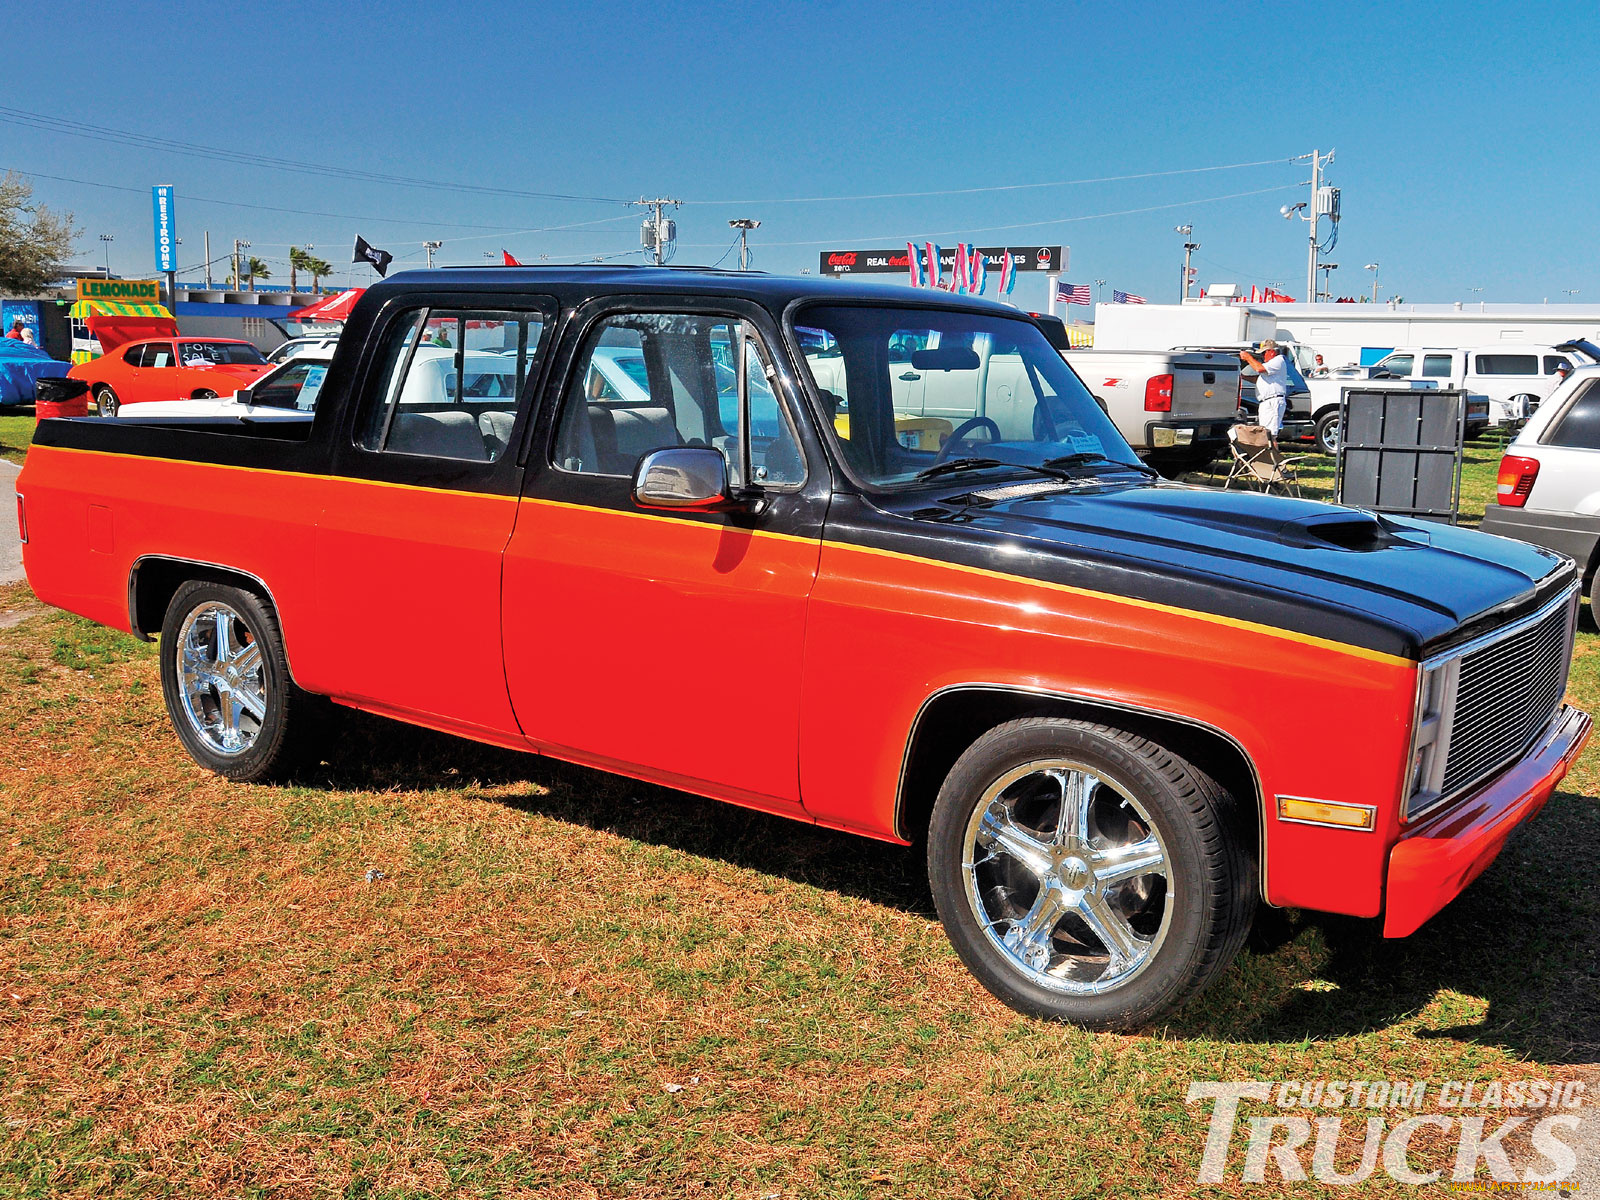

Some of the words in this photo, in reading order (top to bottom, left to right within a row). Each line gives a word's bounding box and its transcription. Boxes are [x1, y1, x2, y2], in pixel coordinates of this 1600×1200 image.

[159, 197, 170, 270] RESTROOMS
[867, 257, 888, 266] REAL
[82, 283, 156, 297] LEMONADE
[184, 343, 217, 353] FOR
[182, 352, 221, 361] SALE
